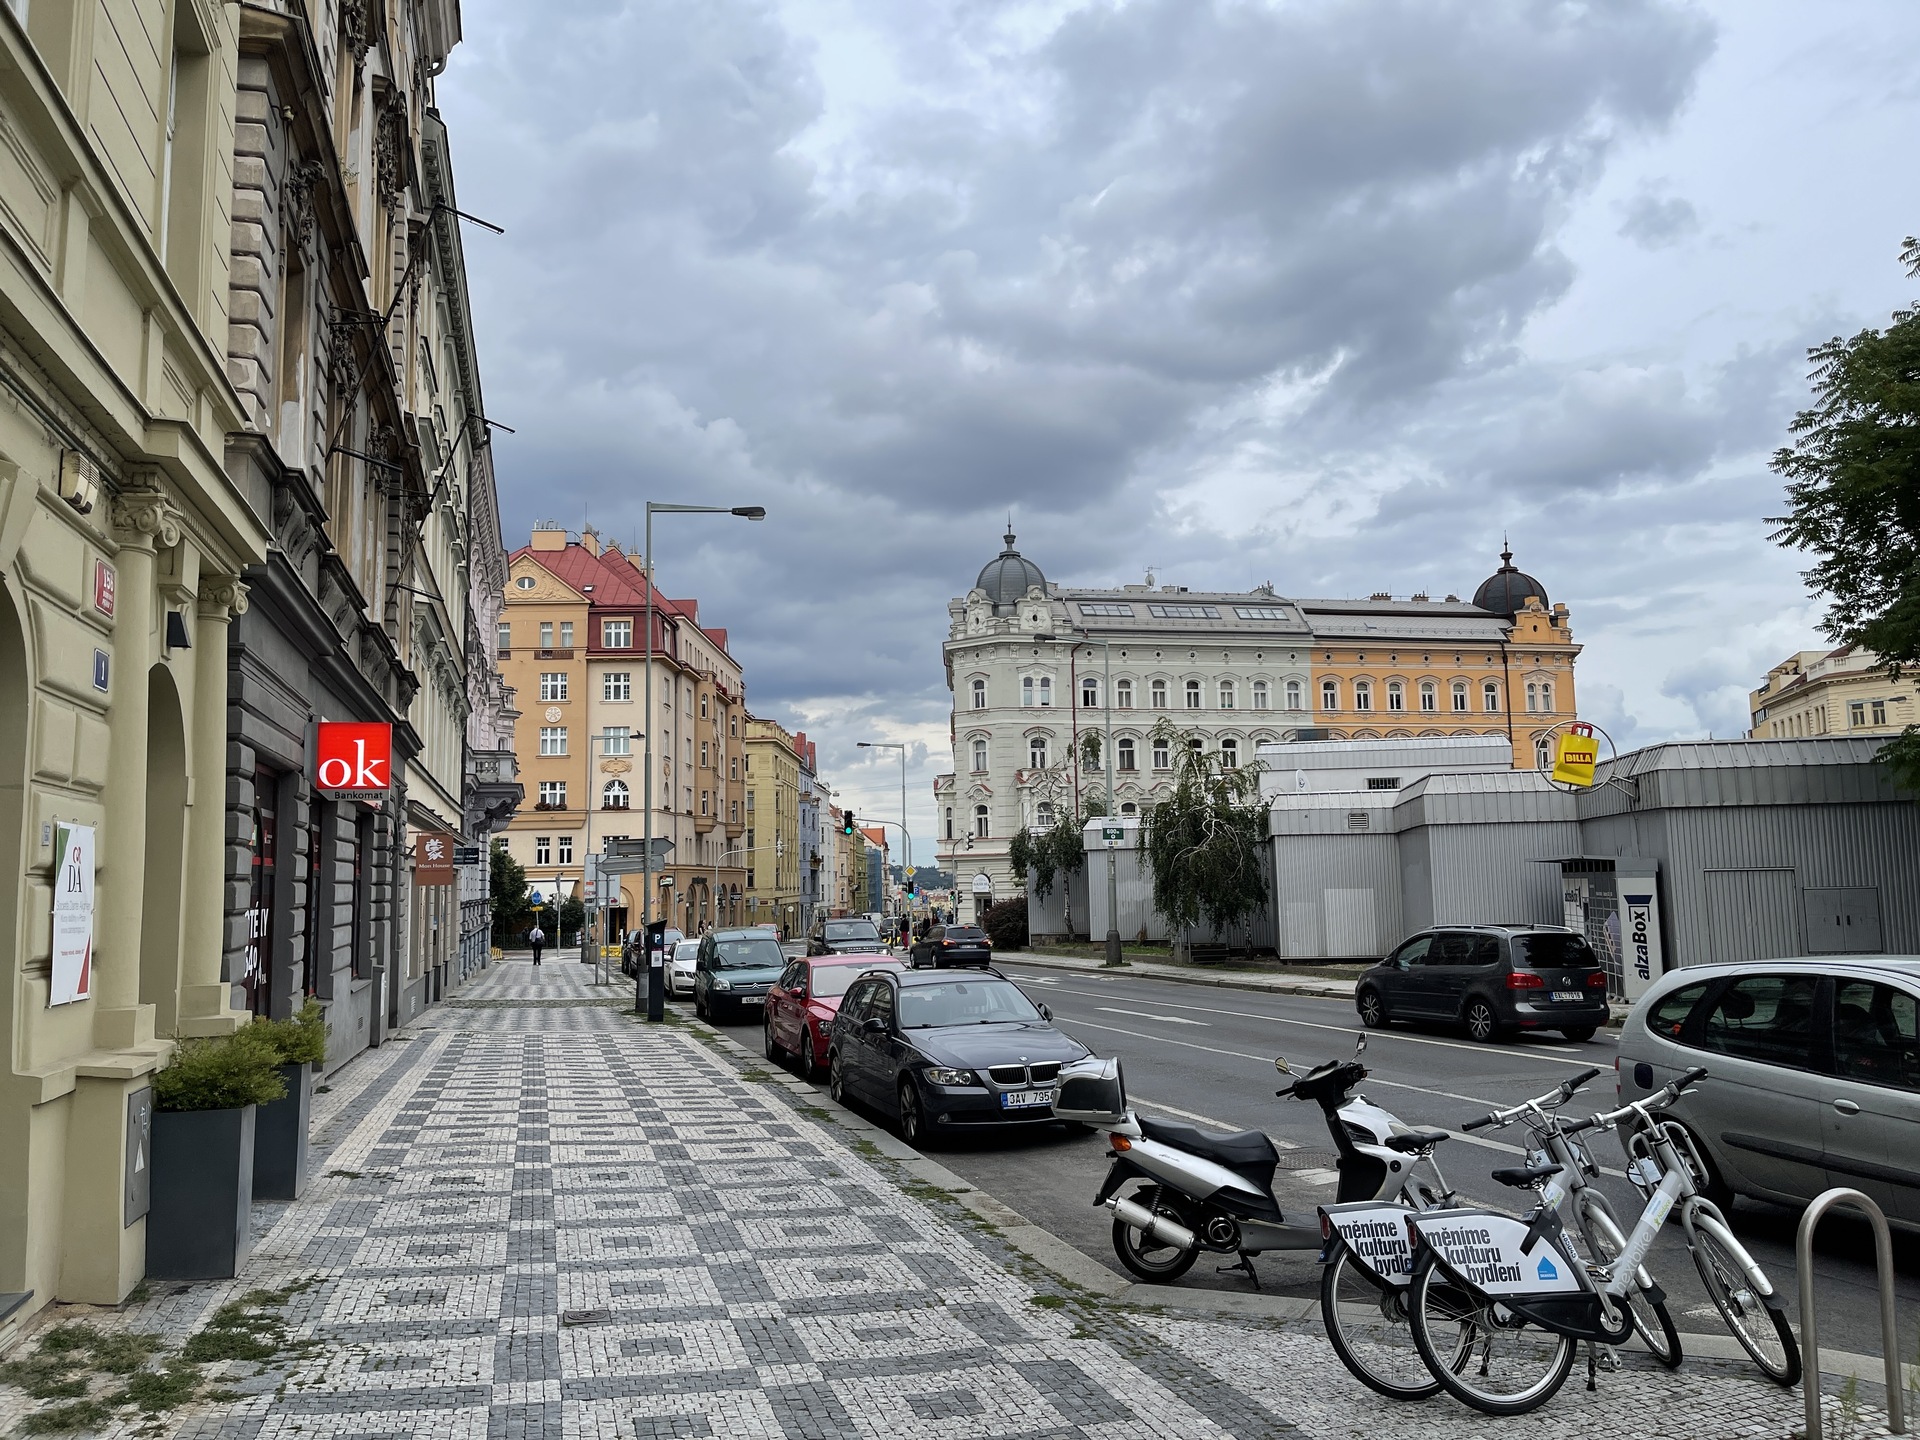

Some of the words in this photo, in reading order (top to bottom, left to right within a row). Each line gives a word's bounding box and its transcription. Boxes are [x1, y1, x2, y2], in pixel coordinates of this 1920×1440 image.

[318, 739, 388, 788] ok
[1565, 753, 1592, 763] BILLA
[334, 791, 383, 800] Bankomat
[654, 933, 661, 943] P
[1632, 910, 1650, 981] alzaBox
[1010, 1093, 1026, 1104] 3AV
[1337, 1219, 1398, 1239] měníme
[1425, 1226, 1491, 1247] měníme
[1354, 1238, 1408, 1257] kulturu
[1444, 1245, 1502, 1265] kulturu
[1616, 1231, 1652, 1292] nextbike
[1465, 1262, 1522, 1285] bydlení
